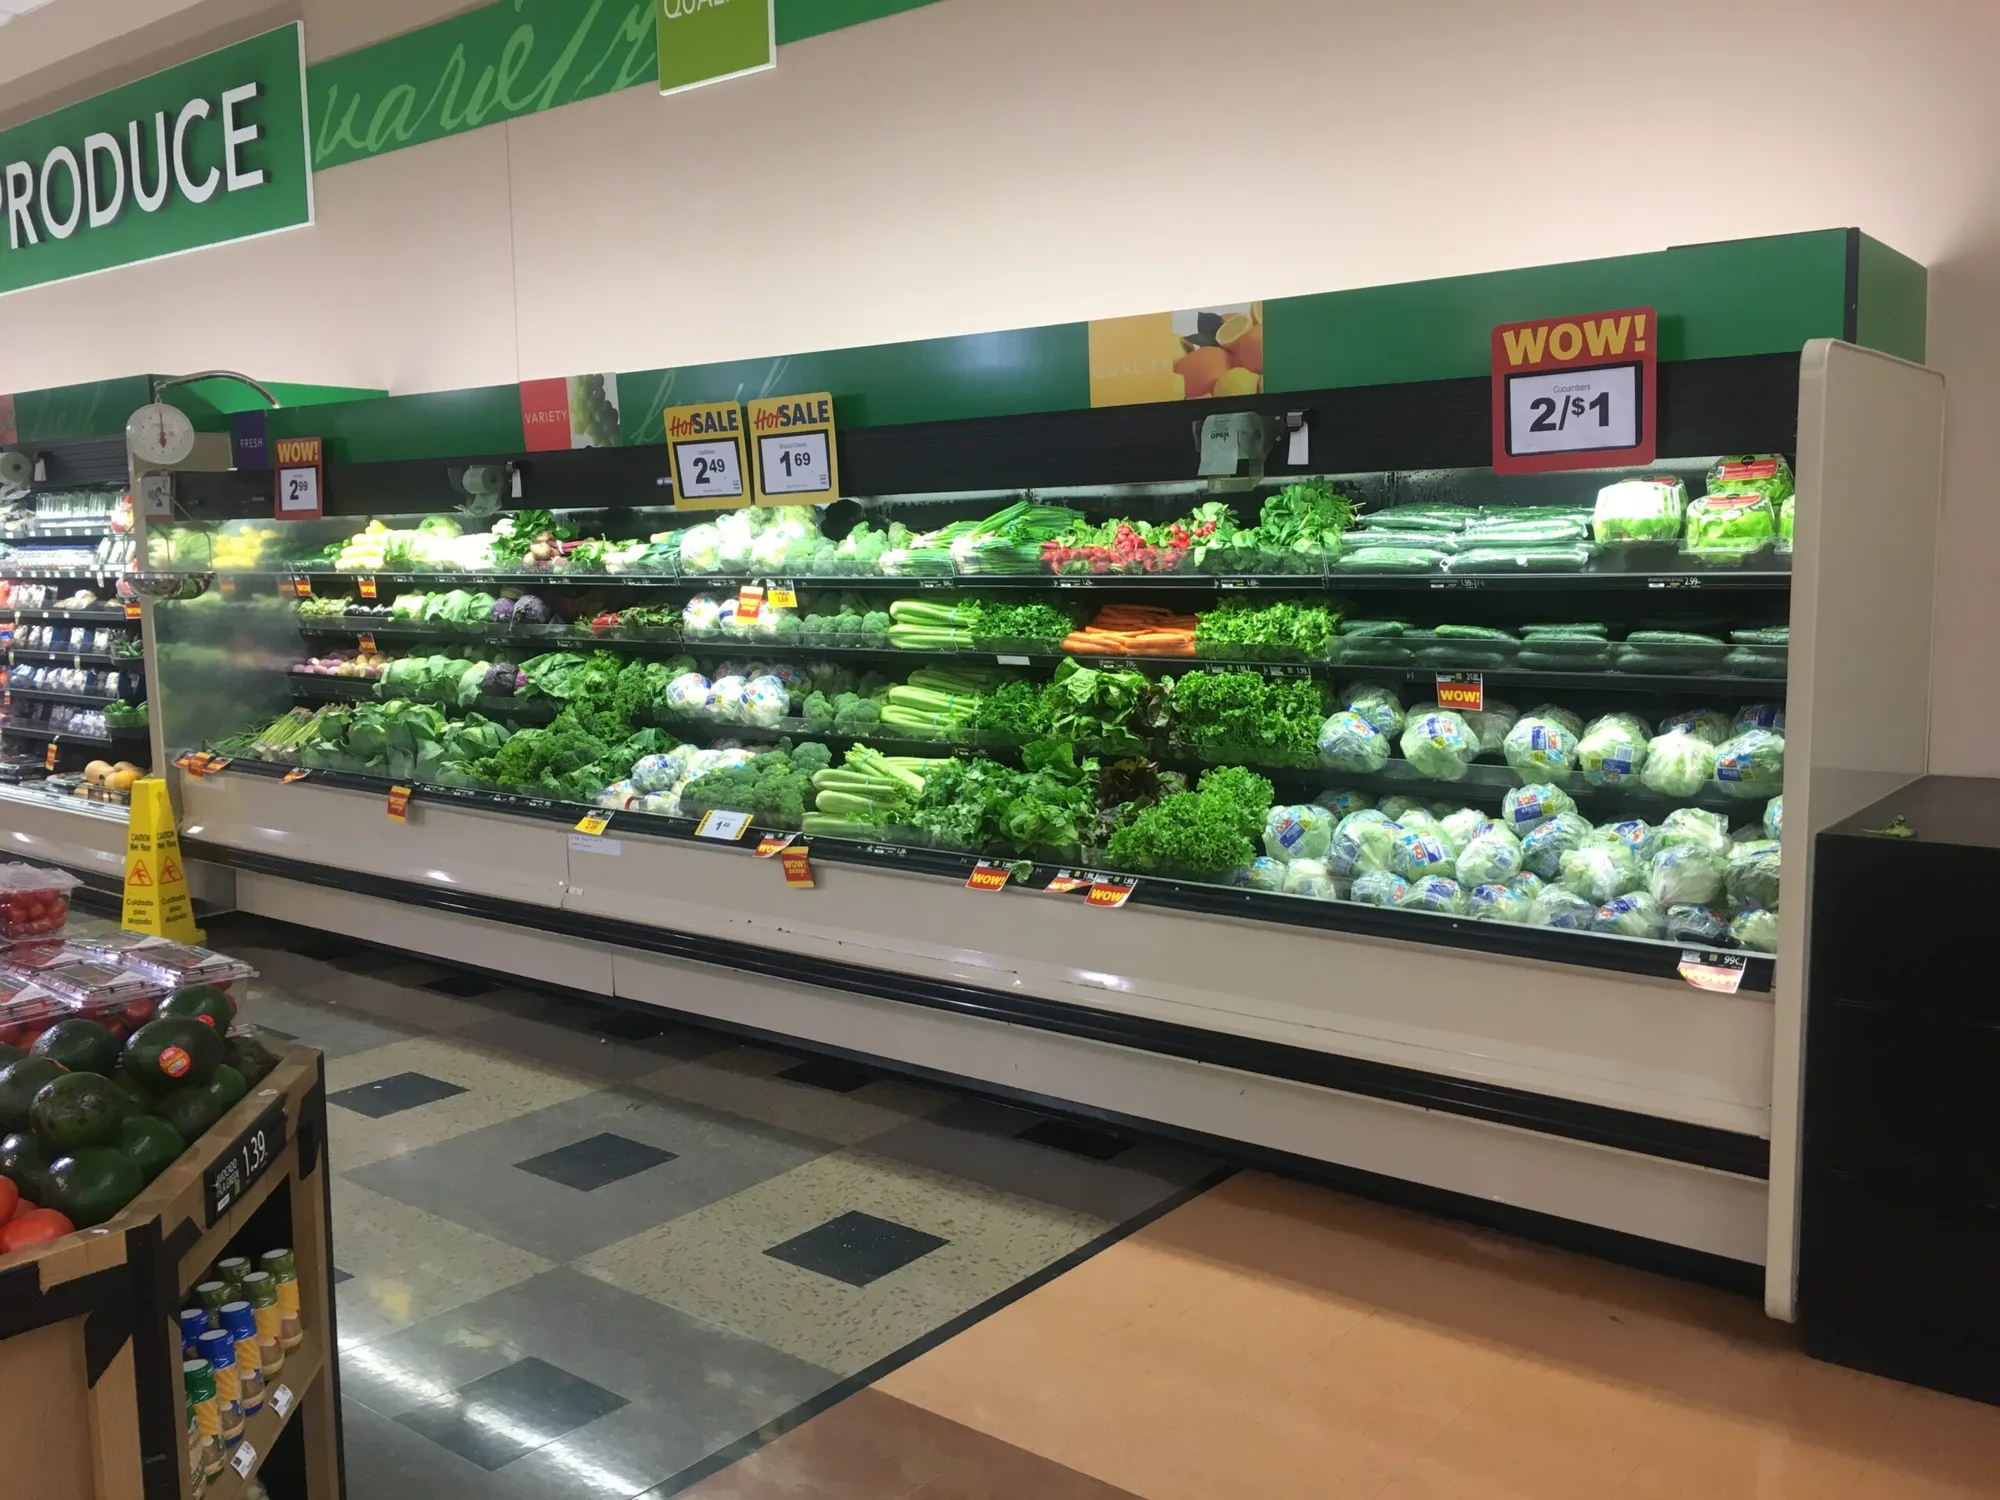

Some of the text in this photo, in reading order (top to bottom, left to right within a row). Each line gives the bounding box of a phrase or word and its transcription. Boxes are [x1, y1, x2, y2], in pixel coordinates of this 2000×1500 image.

[0, 82, 264, 249] RODUCE
[1502, 314, 1646, 366] WOW!
[1553, 383, 1591, 394] Cucumbers
[524, 409, 568, 425] VARIETY
[779, 400, 830, 427] SALE
[1529, 391, 1610, 433] 2/$1
[693, 409, 739, 434] SALE
[1210, 431, 1230, 440] OPEN
[240, 437, 264, 449] FRESH
[277, 440, 319, 463] WOW!
[1440, 690, 1480, 703] WOW!
[784, 859, 807, 869] WOW!
[972, 872, 1006, 886] WOW!
[126, 898, 154, 907] Cuidado
[161, 894, 186, 905] Cuidado
[127, 917, 153, 926] Mojado
[242, 1130, 266, 1177] 1.39
